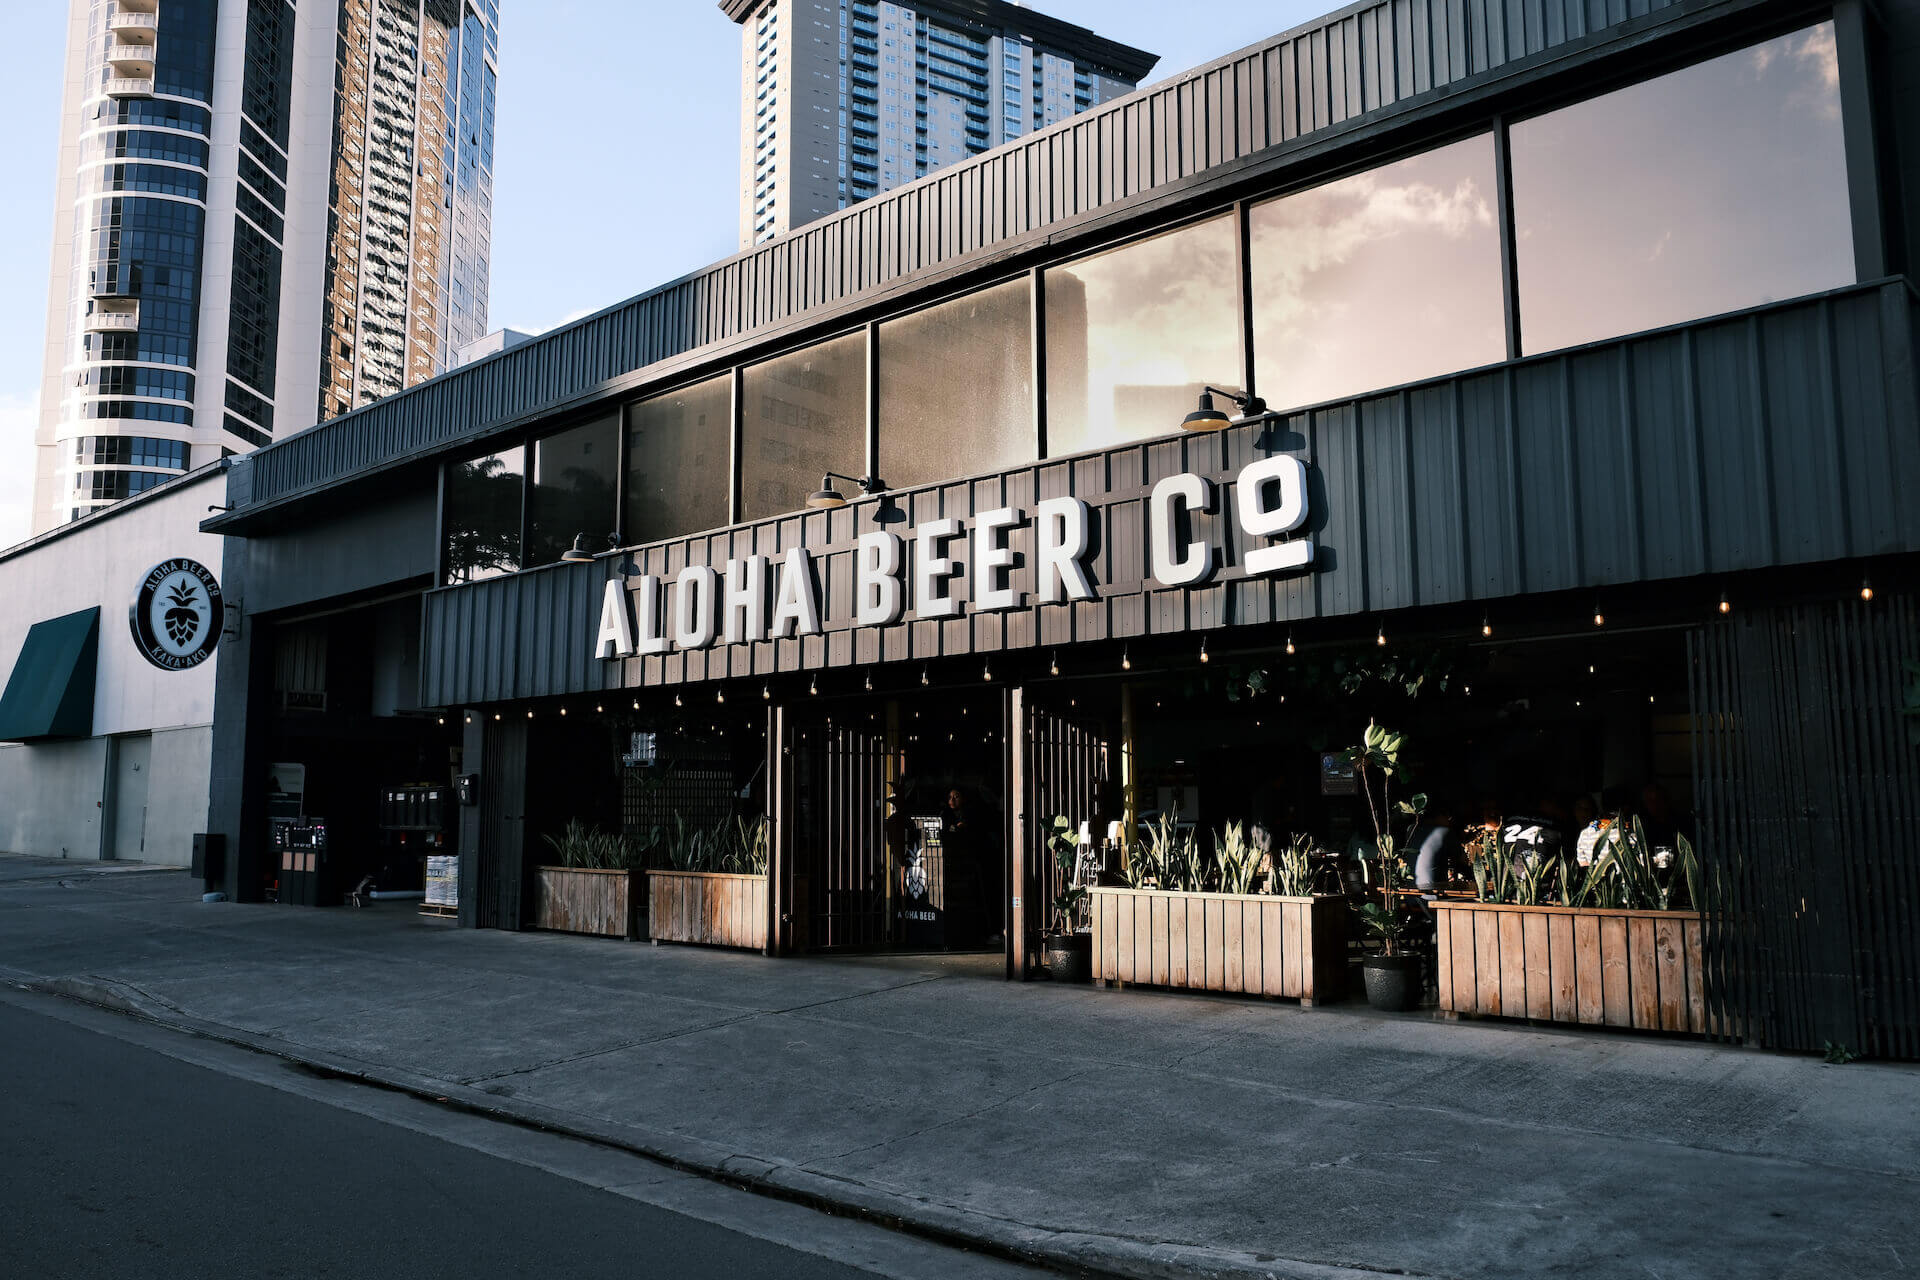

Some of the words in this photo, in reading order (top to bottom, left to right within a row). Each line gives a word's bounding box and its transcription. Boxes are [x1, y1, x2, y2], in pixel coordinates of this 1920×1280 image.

[145, 561, 178, 592] ALOHA
[182, 560, 211, 583] BEER
[595, 547, 819, 659] ALOHA
[858, 496, 1094, 626] BEER
[897, 909, 919, 920] AOHA
